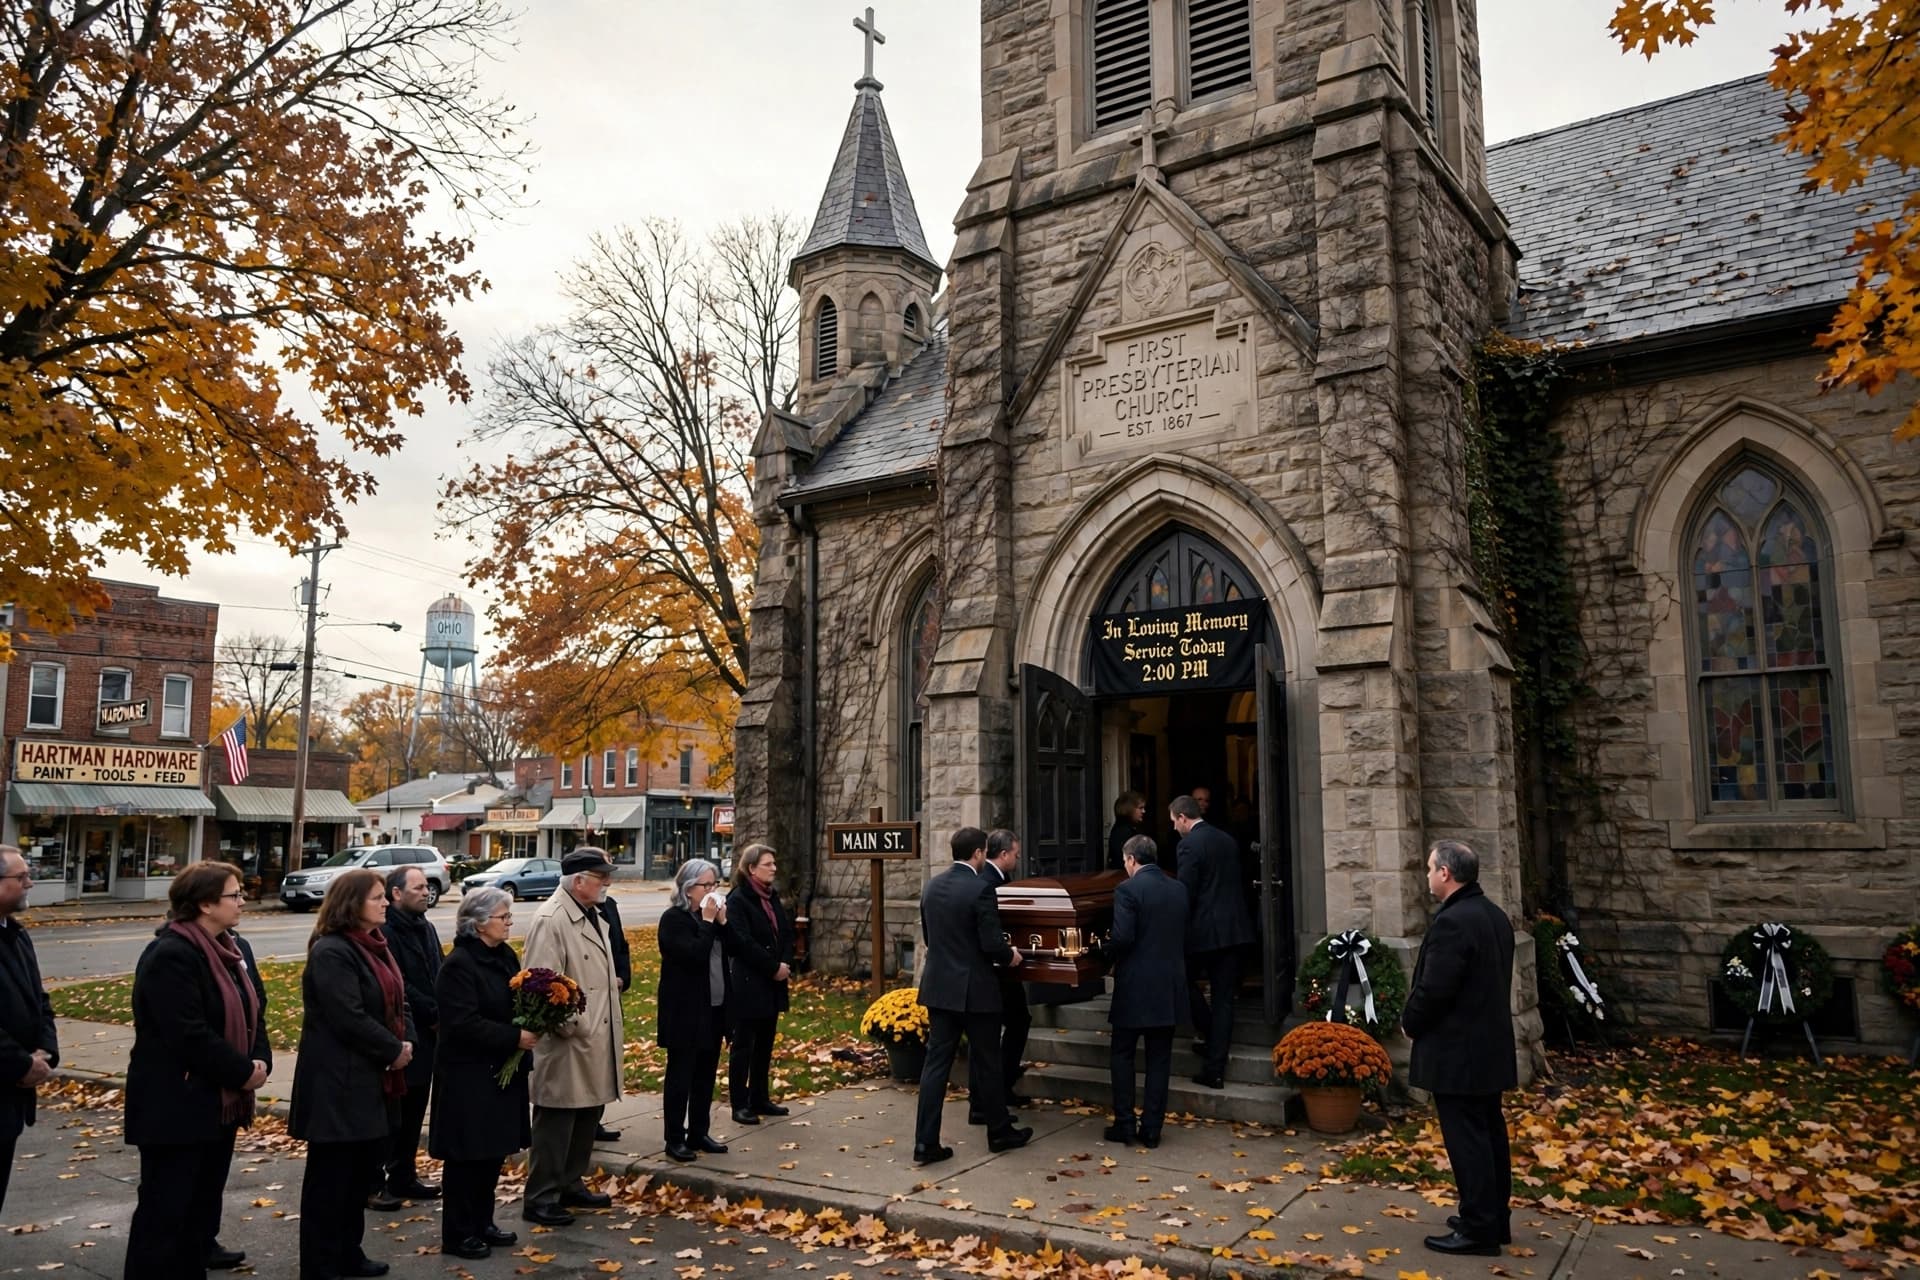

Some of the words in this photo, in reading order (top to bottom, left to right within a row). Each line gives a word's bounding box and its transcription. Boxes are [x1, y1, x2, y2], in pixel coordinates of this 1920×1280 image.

[1127, 333, 1187, 367] FIRST
[1082, 348, 1240, 402] PRESBYTERIAN
[1115, 383, 1198, 421] CHURCH
[1127, 420, 1155, 437] EST.
[1162, 413, 1193, 431] 1867
[437, 620, 462, 635] OHIO
[1102, 619, 1122, 640] In
[1127, 617, 1179, 638] Loving
[1184, 612, 1248, 633] Memory
[1123, 642, 1174, 662] Service
[1179, 638, 1226, 656] Today
[1142, 662, 1175, 682] 2:00
[1181, 659, 1209, 680] PM
[21, 744, 106, 766] HARTMAN
[112, 747, 198, 770] HARDWARE
[33, 766, 74, 779] PAINT
[94, 769, 135, 781] TOOLS
[155, 771, 185, 783] FEED
[842, 832, 877, 850] MAIN
[884, 831, 904, 849] ST.
